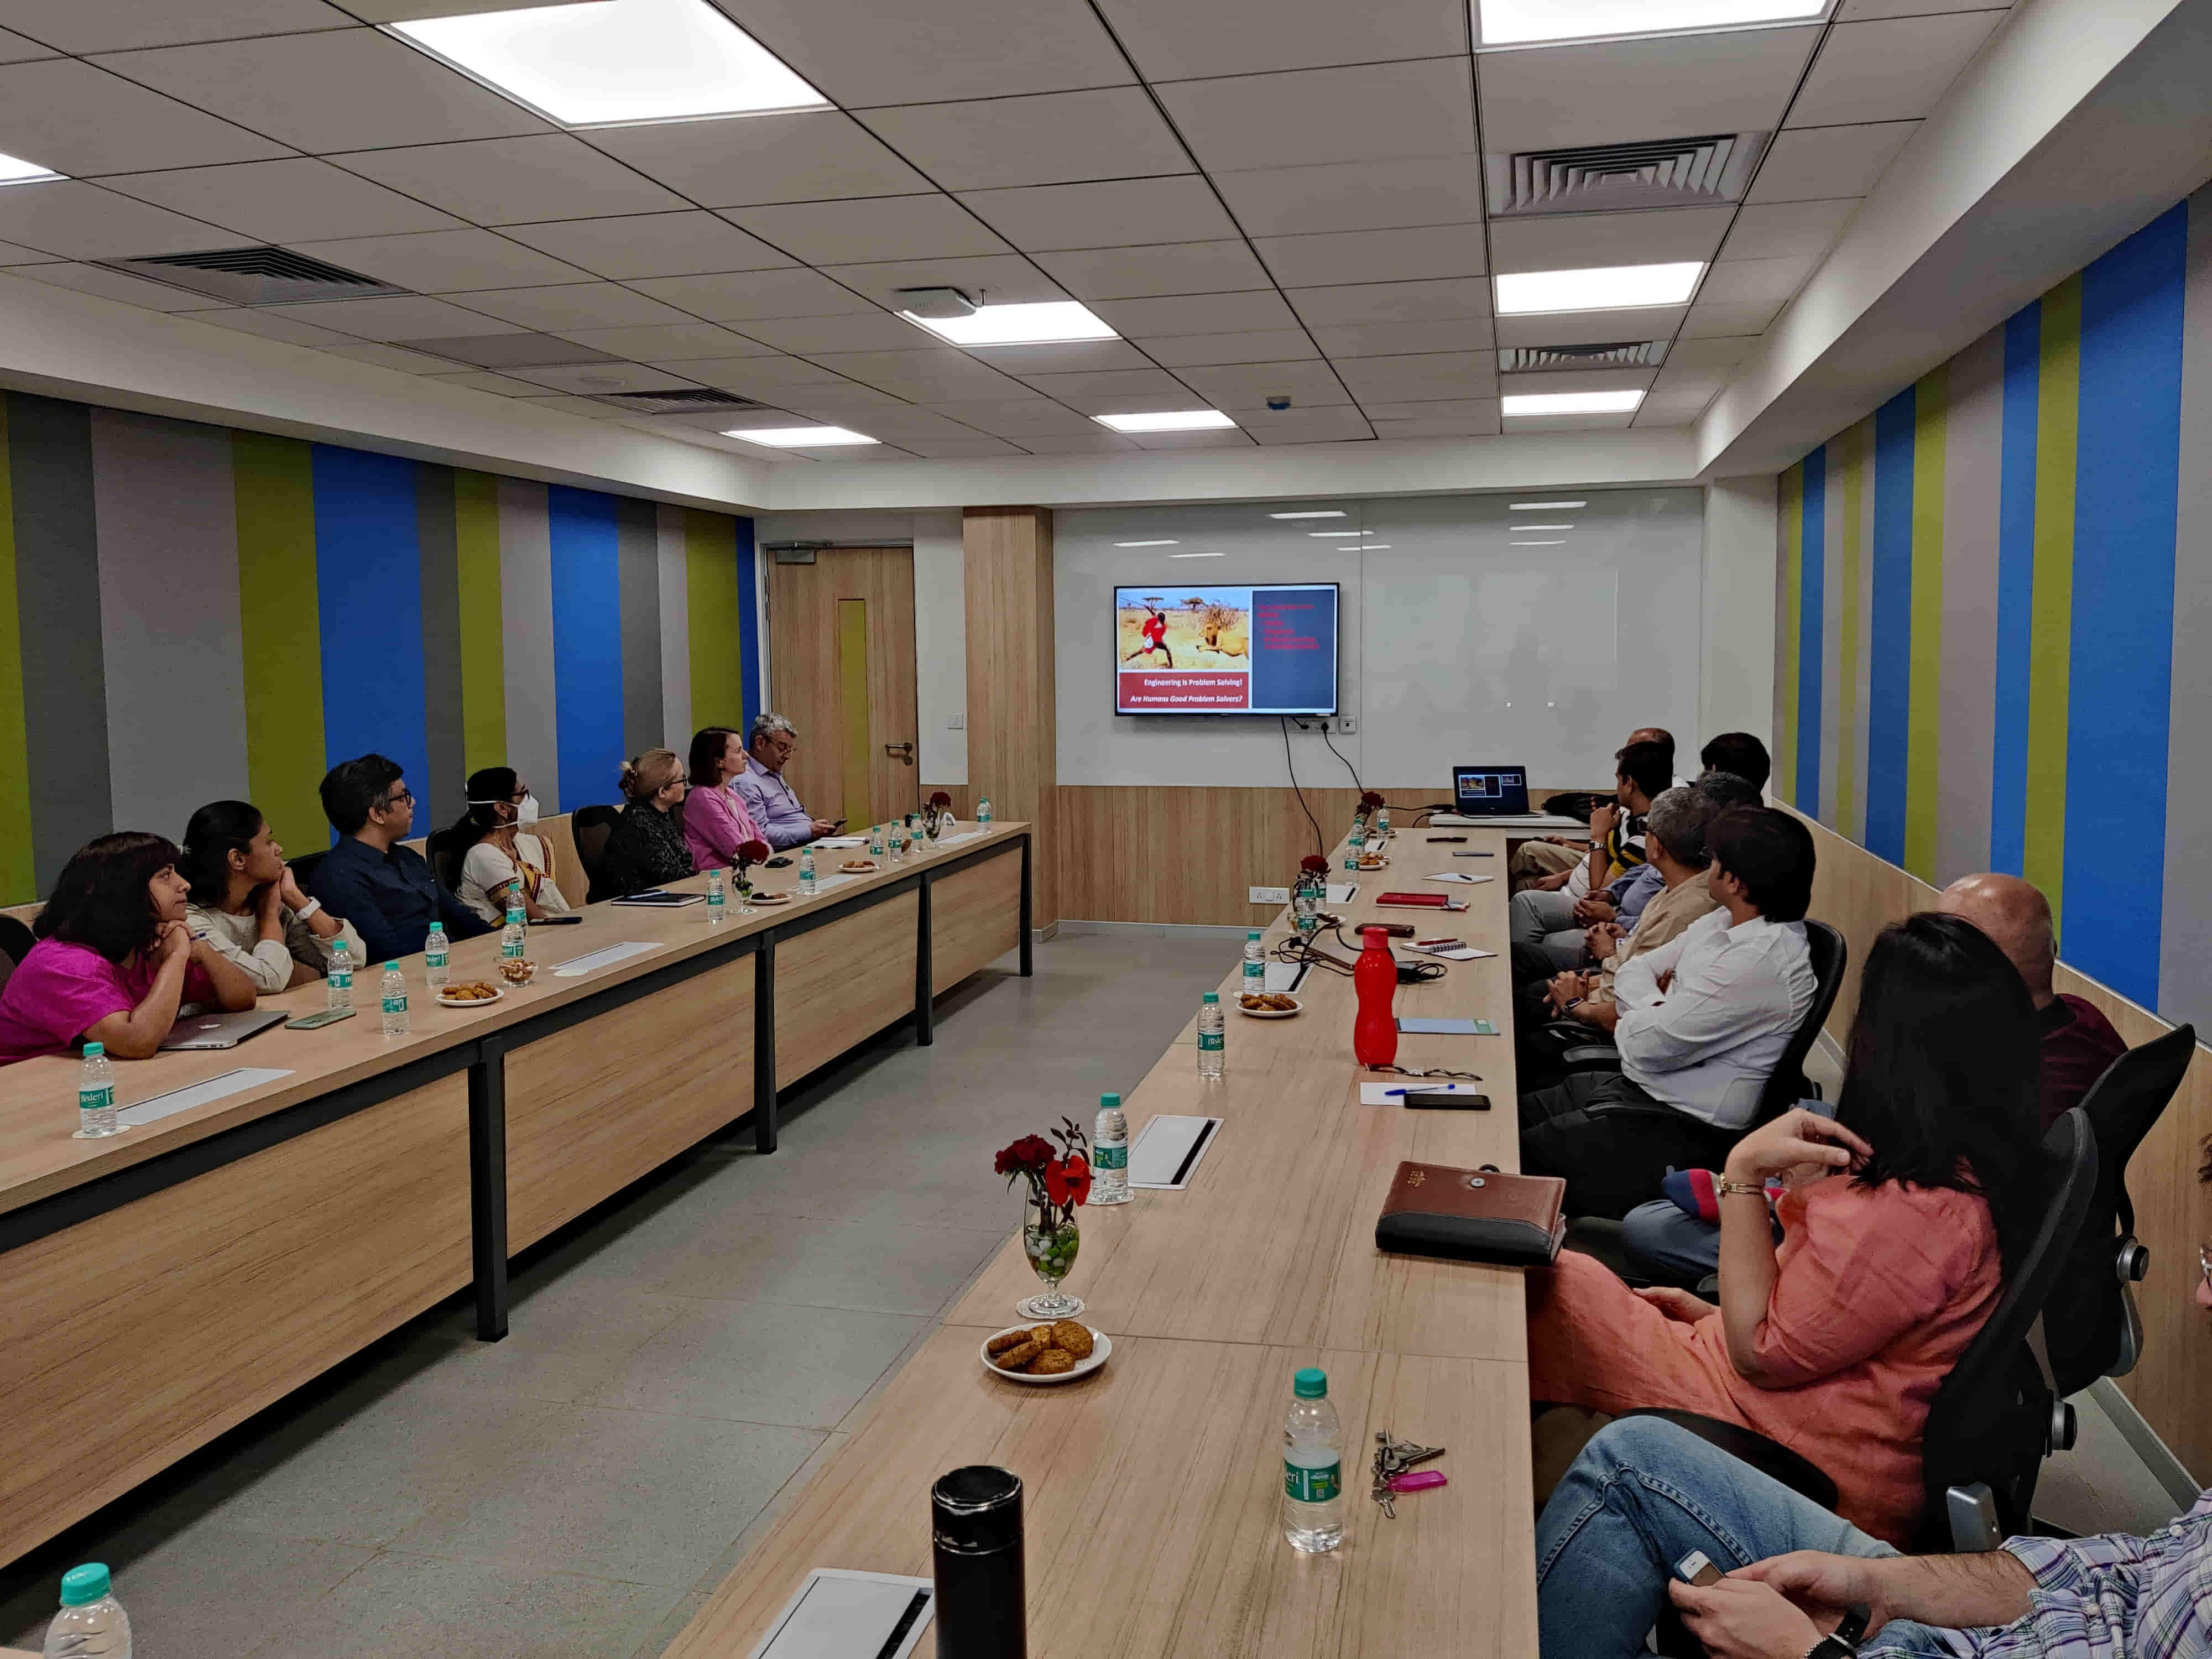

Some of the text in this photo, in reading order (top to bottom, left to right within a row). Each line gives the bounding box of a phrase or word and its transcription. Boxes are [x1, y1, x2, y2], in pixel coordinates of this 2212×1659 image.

[1144, 679, 1182, 687] Engineering
[1217, 679, 1243, 687] Solving!
[81, 1092, 103, 1102] Bisleri
